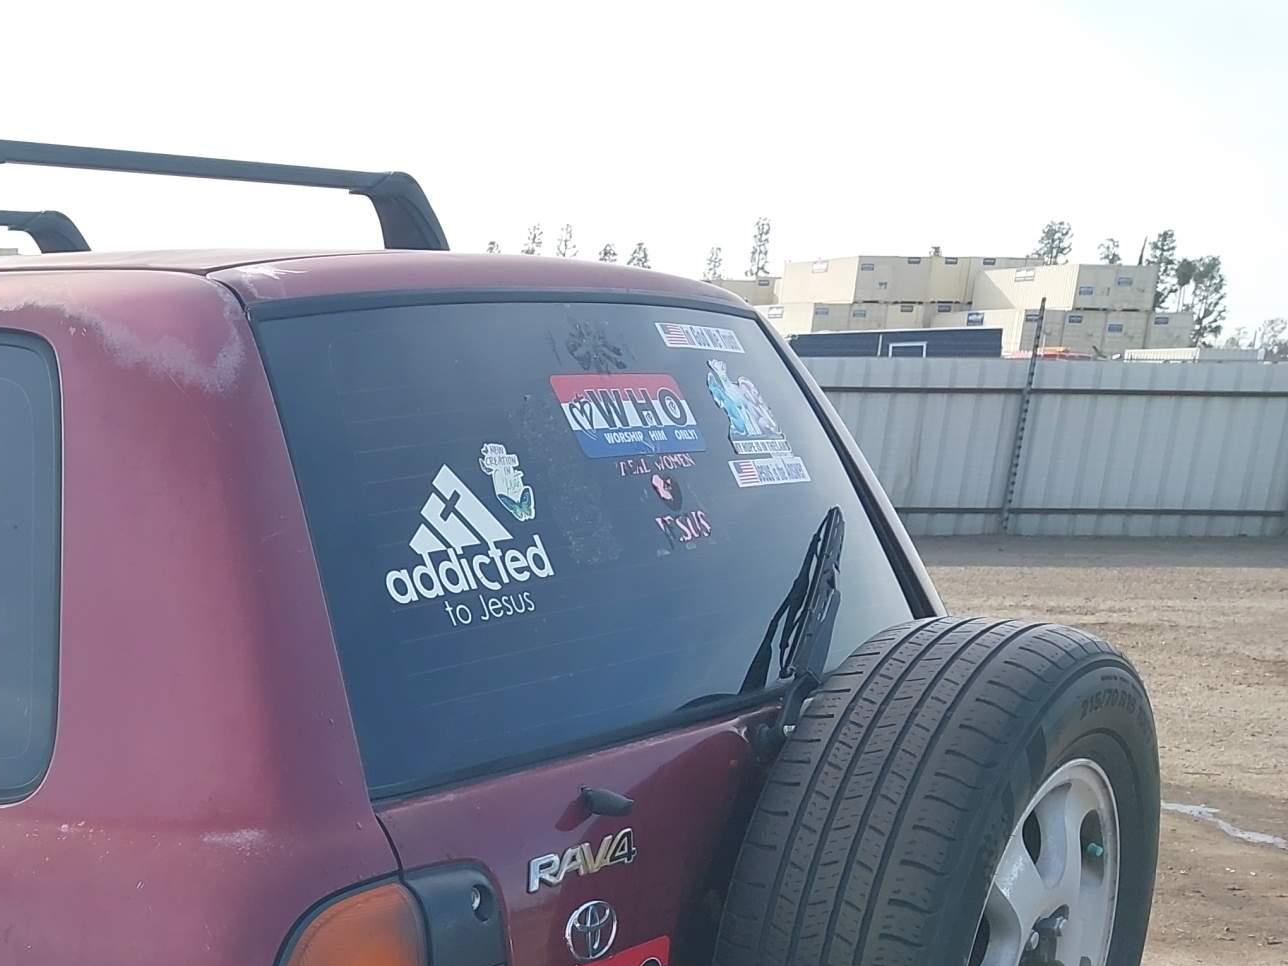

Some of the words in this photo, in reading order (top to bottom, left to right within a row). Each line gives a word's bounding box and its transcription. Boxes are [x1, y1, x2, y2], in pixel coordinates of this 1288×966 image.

[584, 387, 688, 428] WHO
[604, 431, 644, 444] WORSHIP
[649, 430, 667, 441] HIM
[654, 453, 696, 471] WOMEN
[386, 534, 555, 604] addicted
[445, 600, 472, 626] to
[481, 592, 535, 620] Jesus
[527, 828, 637, 893] RAV4
